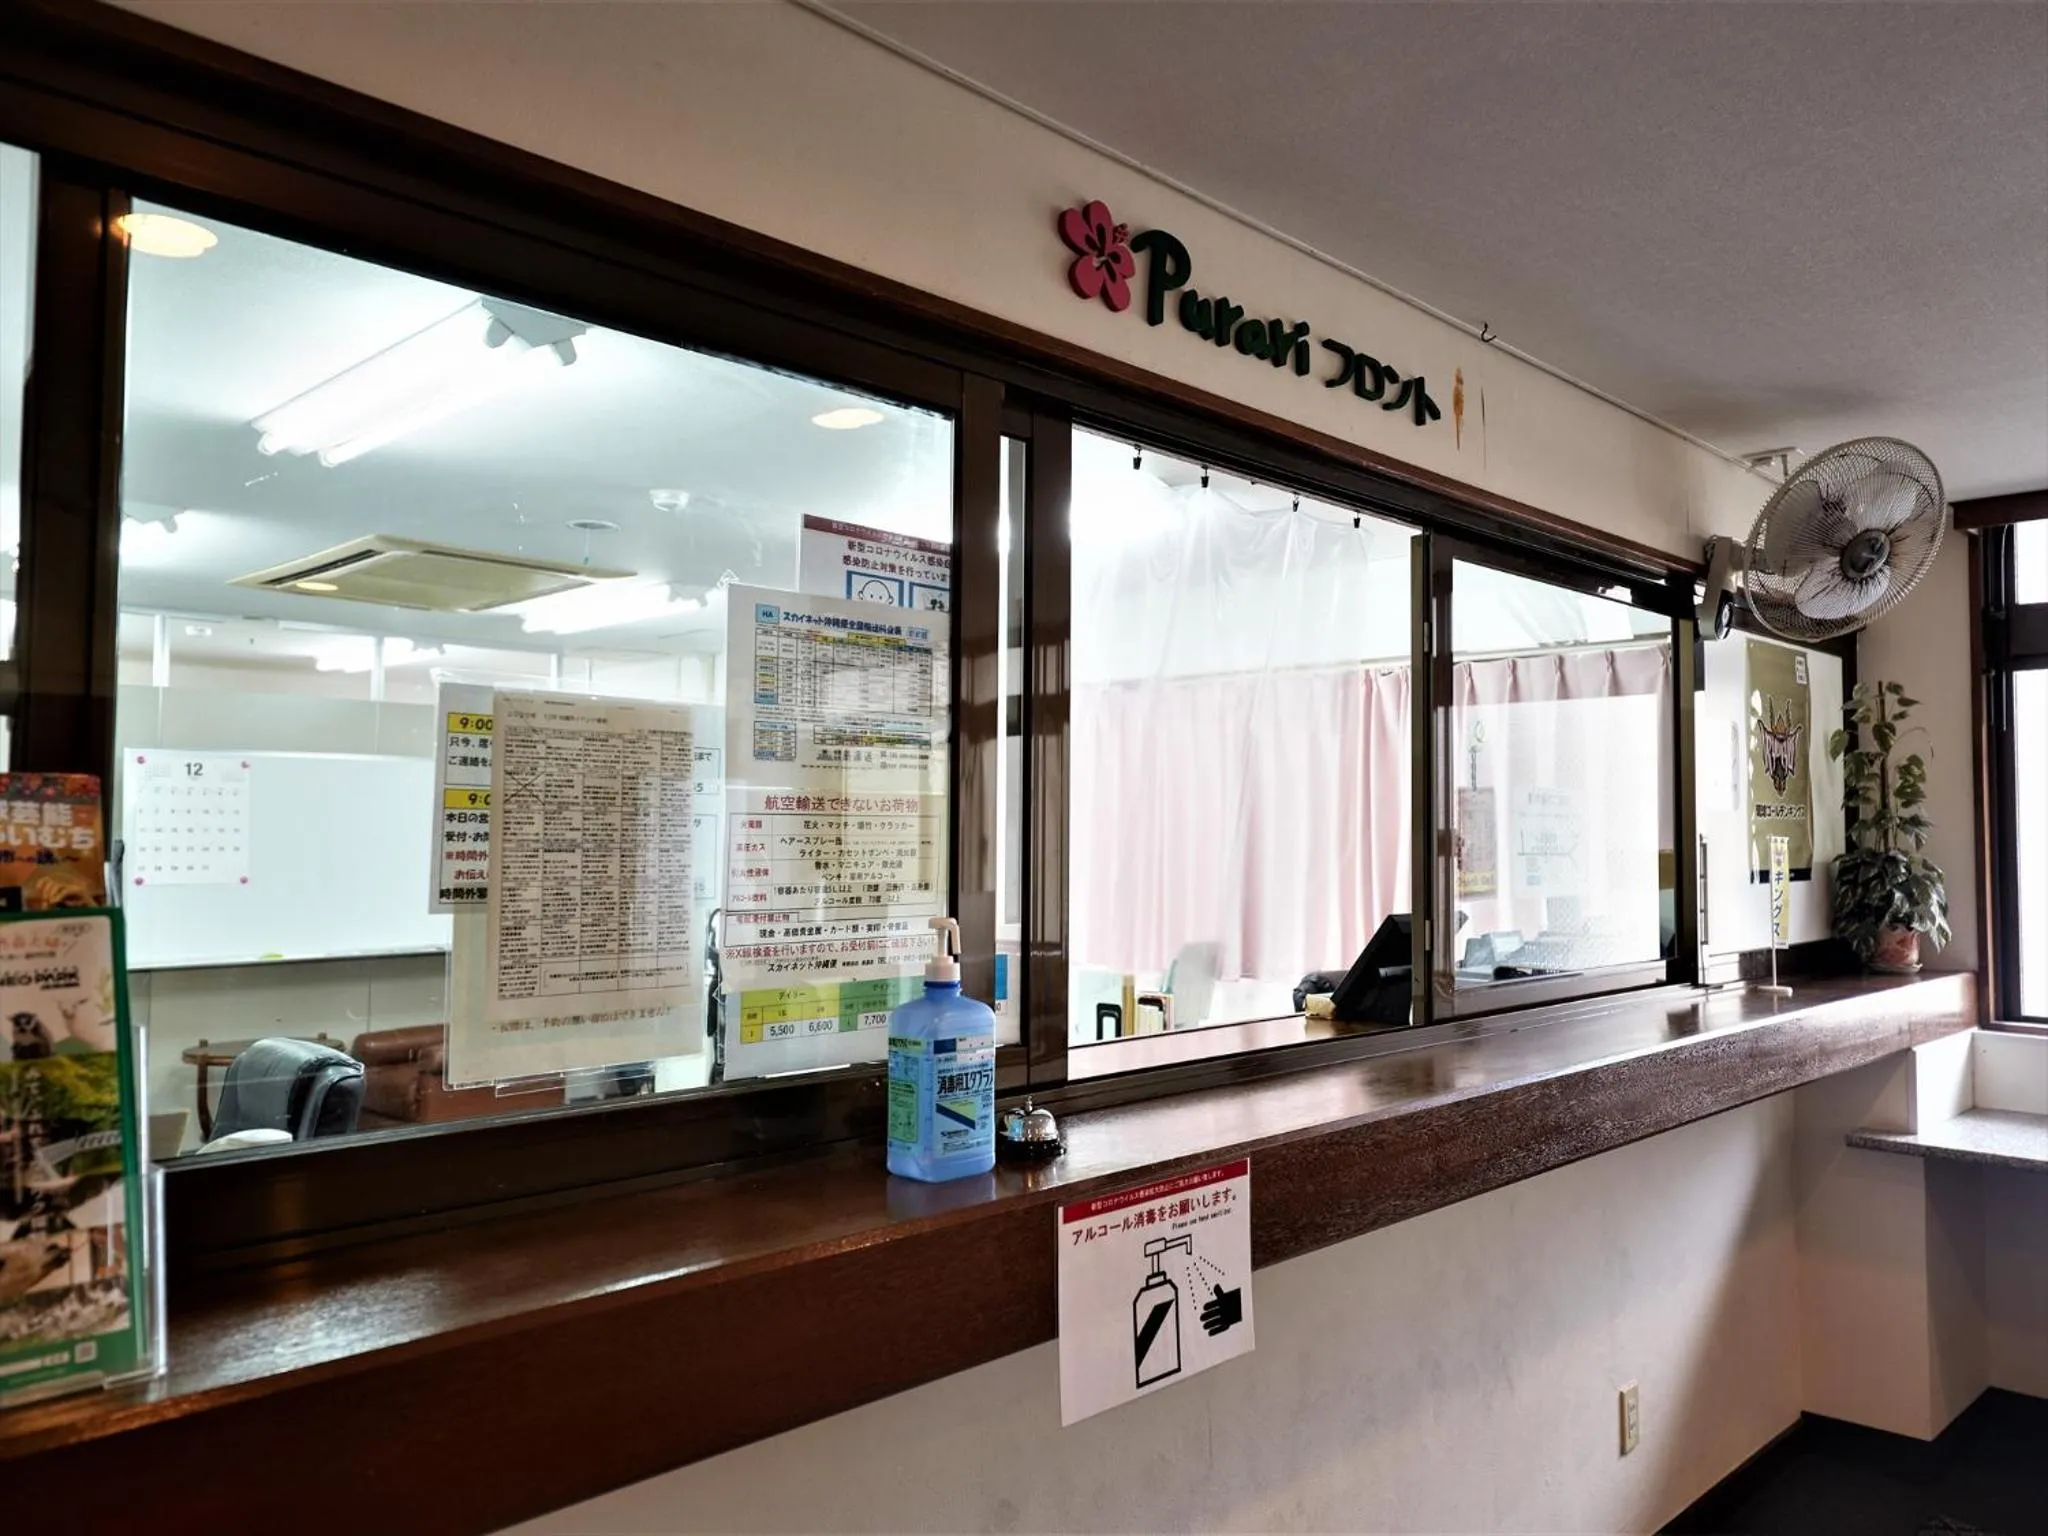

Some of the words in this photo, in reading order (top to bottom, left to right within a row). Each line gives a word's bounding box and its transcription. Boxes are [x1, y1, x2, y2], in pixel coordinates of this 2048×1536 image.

[1131, 229, 1309, 376] Purari
[1322, 338, 1441, 426] フロント
[185, 762, 204, 776] 12
[764, 795, 918, 813] 航空輸送できないお荷物
[770, 1025, 794, 1037] 5,500
[864, 1013, 886, 1026] 7,700
[1072, 1187, 1236, 1246] アルコール消毒をお願いします。
